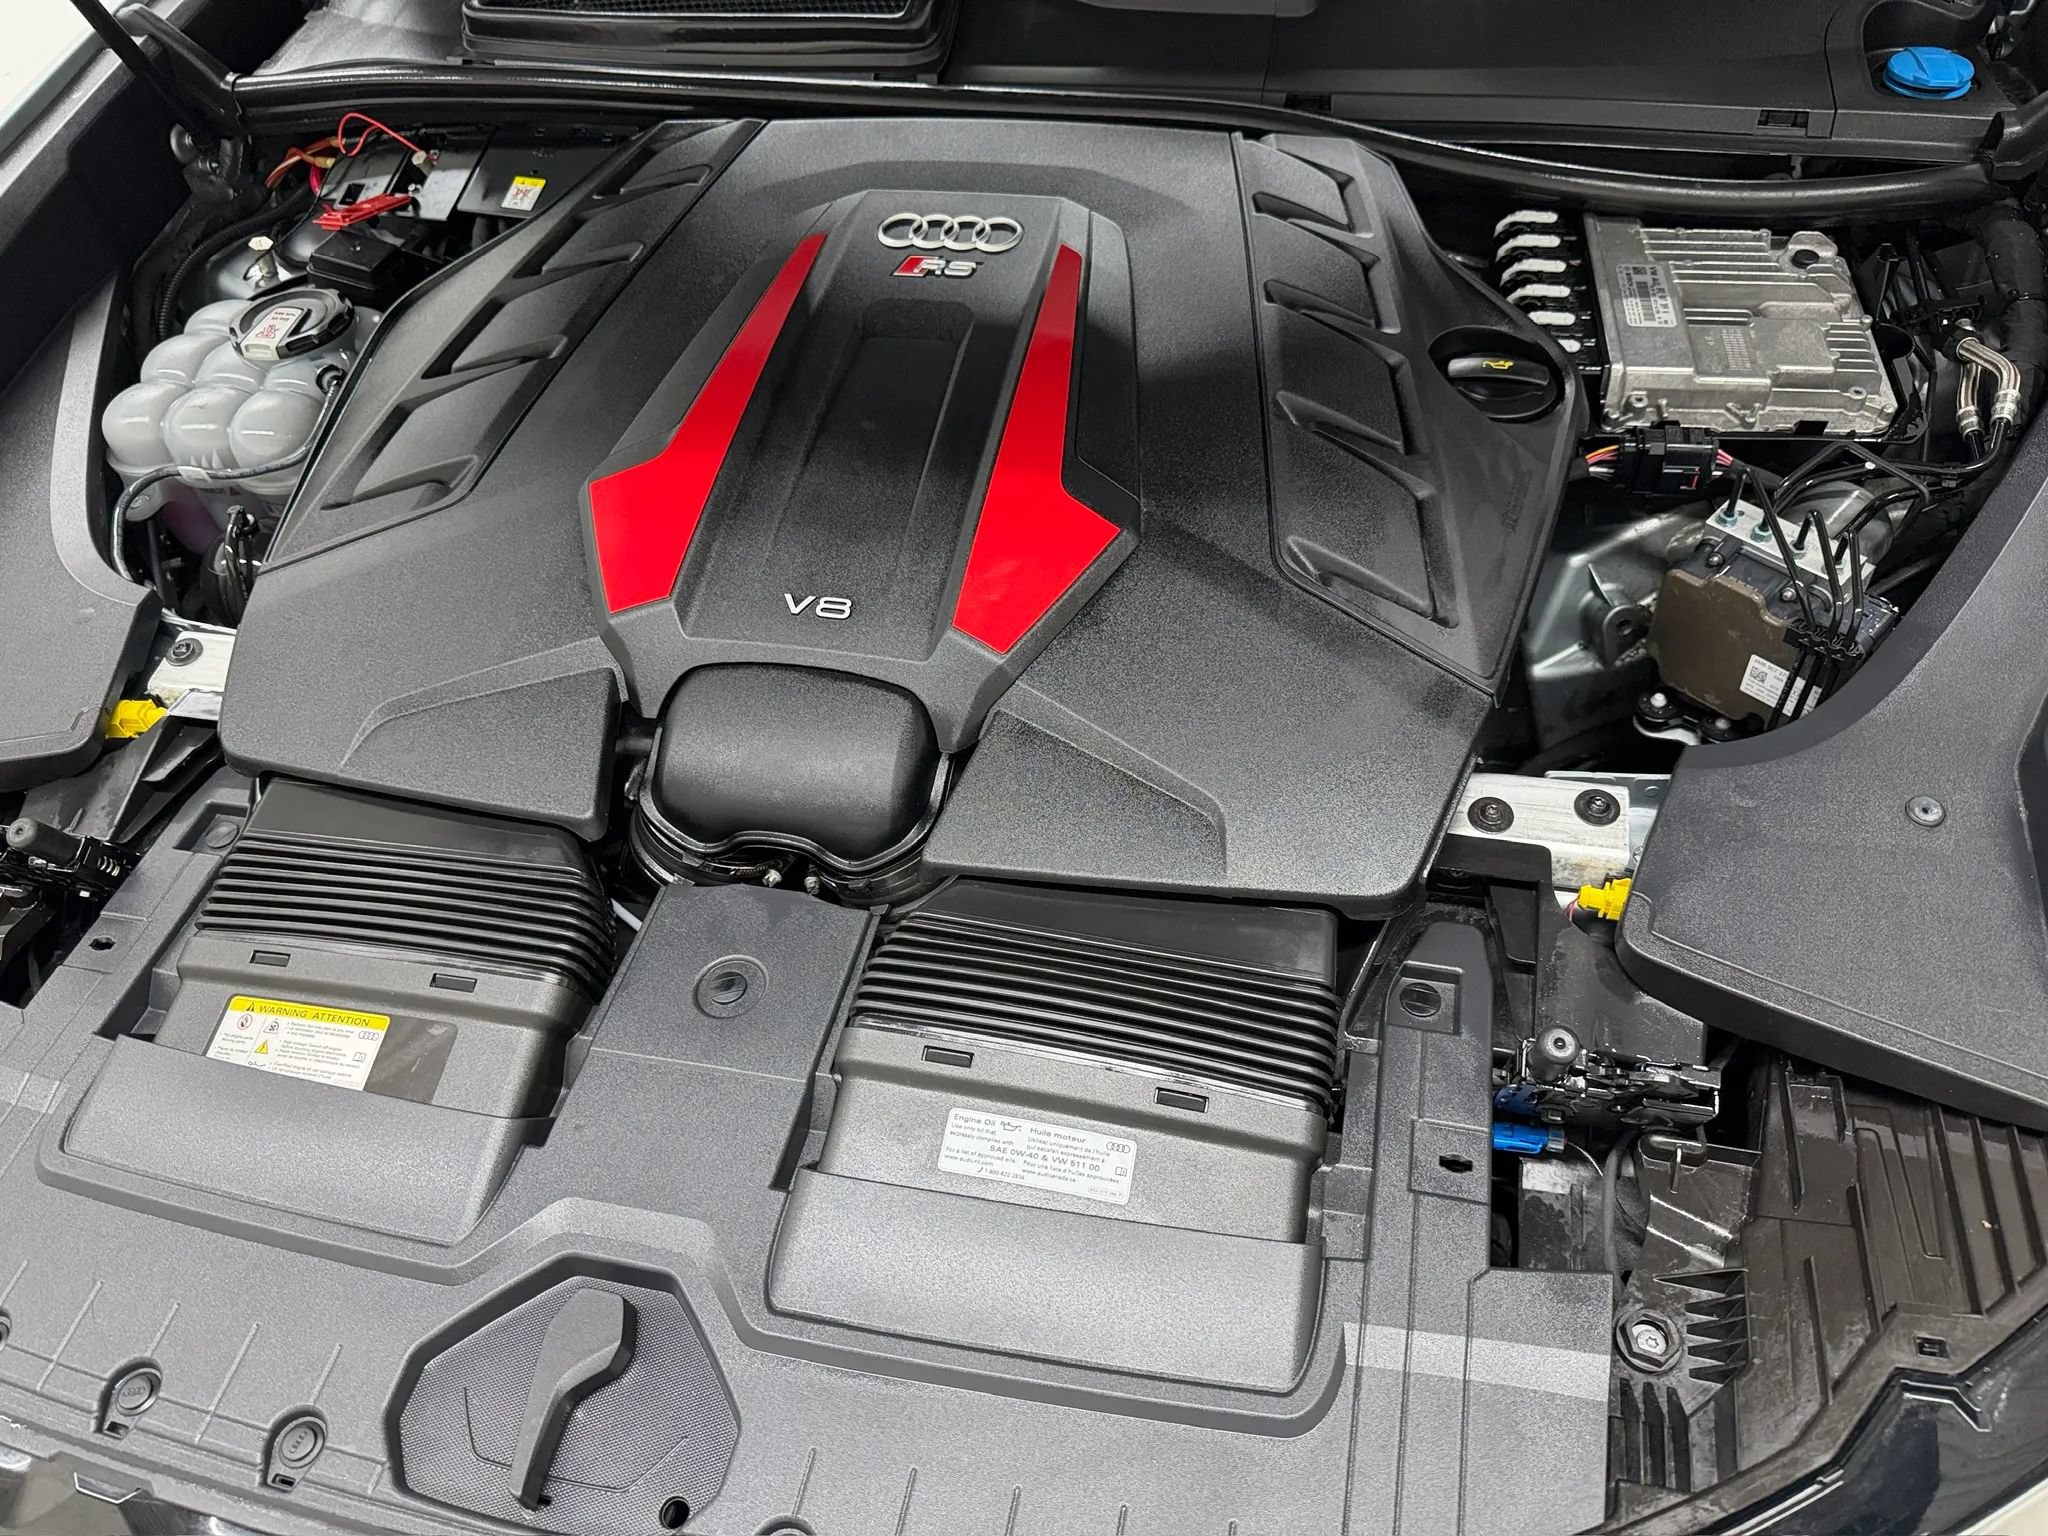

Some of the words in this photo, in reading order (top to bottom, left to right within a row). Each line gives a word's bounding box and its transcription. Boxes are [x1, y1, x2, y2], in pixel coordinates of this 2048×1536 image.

[894, 255, 977, 277] RS
[784, 593, 852, 619] V8
[259, 1005, 308, 1018] WARNING
[312, 1012, 370, 1027] ATTENTION
[953, 1113, 982, 1124] Engine
[984, 1118, 996, 1126] Oil
[963, 1124, 976, 1132] only
[985, 1128, 997, 1136] that
[1030, 1127, 1052, 1137] Huile
[1054, 1132, 1087, 1144] moteur
[1028, 1136, 1049, 1145] Utilisez
[989, 1145, 1008, 1154] SAE
[1010, 1149, 1039, 1160] 0W-40
[1052, 1156, 1068, 1165] VW
[1070, 1160, 1086, 1169] 511
[1023, 1160, 1037, 1168] Pour
